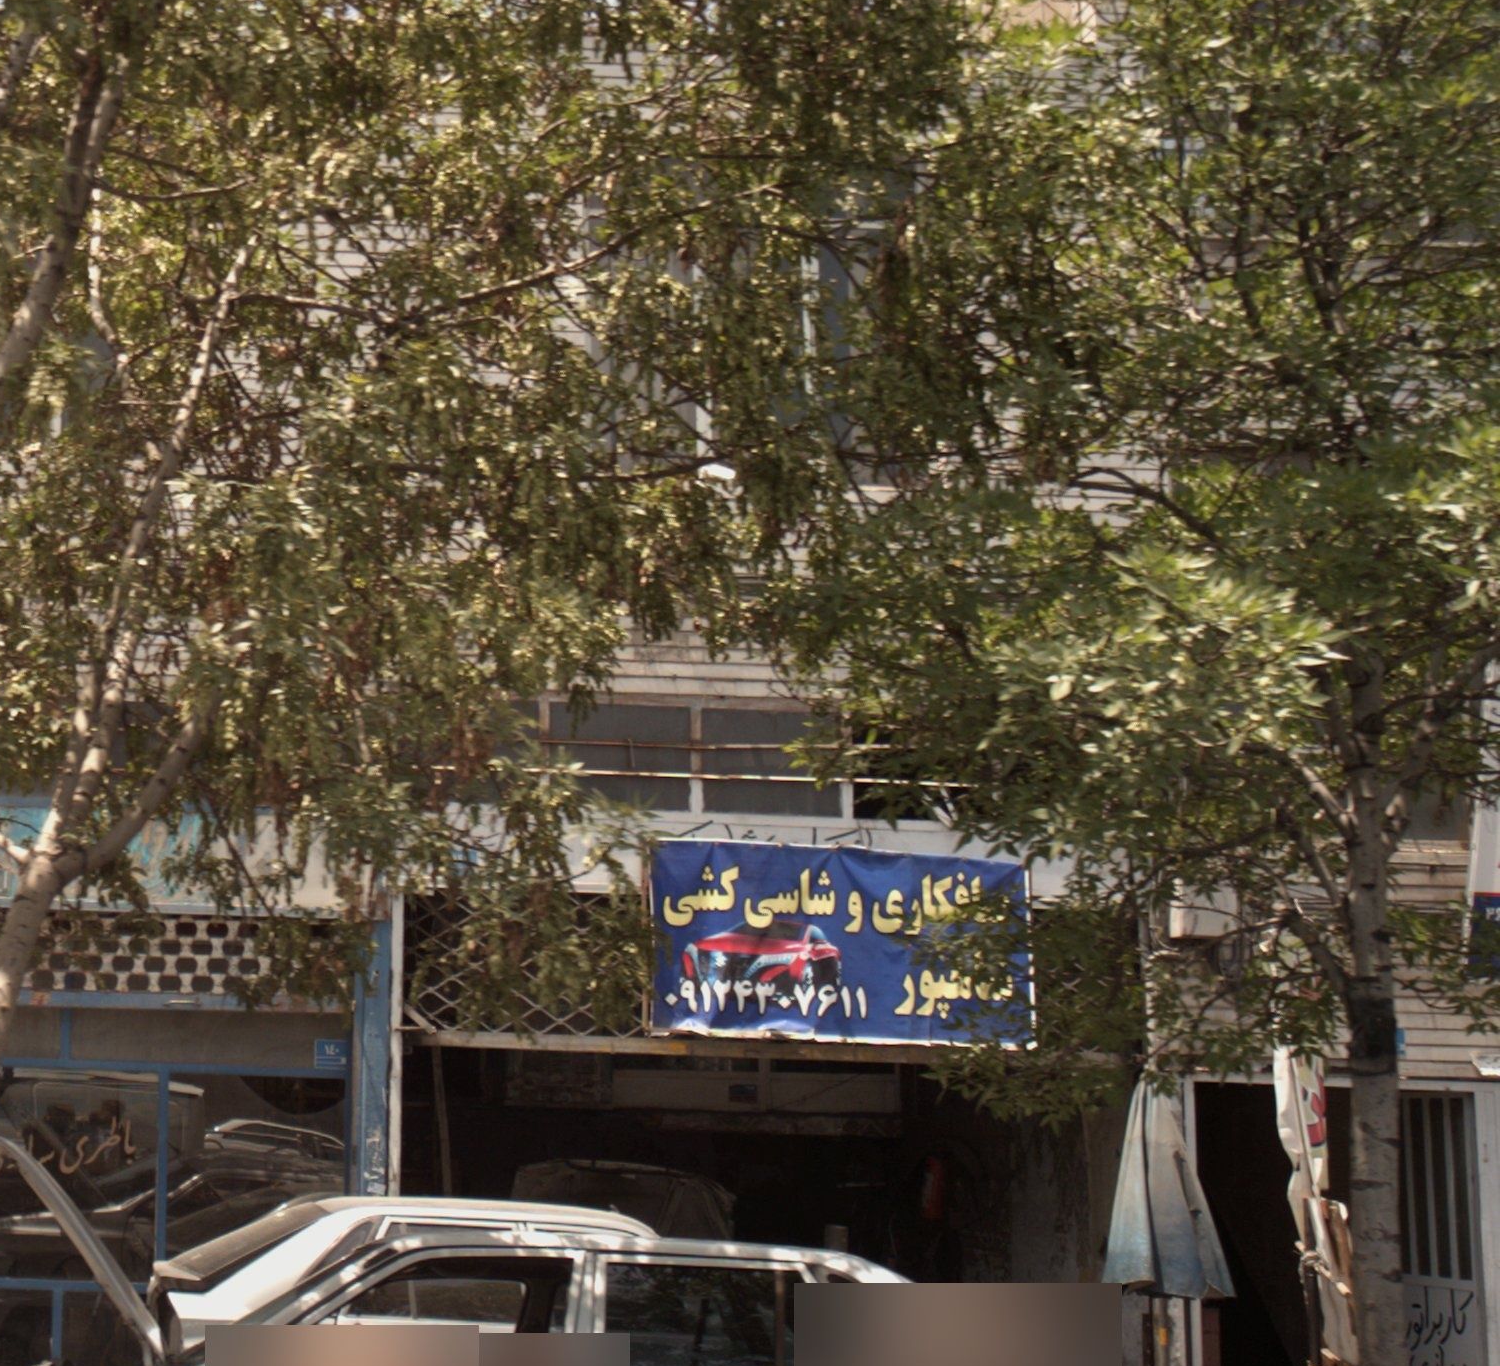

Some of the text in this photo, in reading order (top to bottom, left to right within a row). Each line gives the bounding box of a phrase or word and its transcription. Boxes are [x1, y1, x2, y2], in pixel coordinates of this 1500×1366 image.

[662, 866, 740, 928] کشی
[743, 869, 837, 930] شاسی
[843, 888, 863, 934] و
[664, 979, 868, 1020] ۰۹۱۲۴۳۰۷۶۱۱
